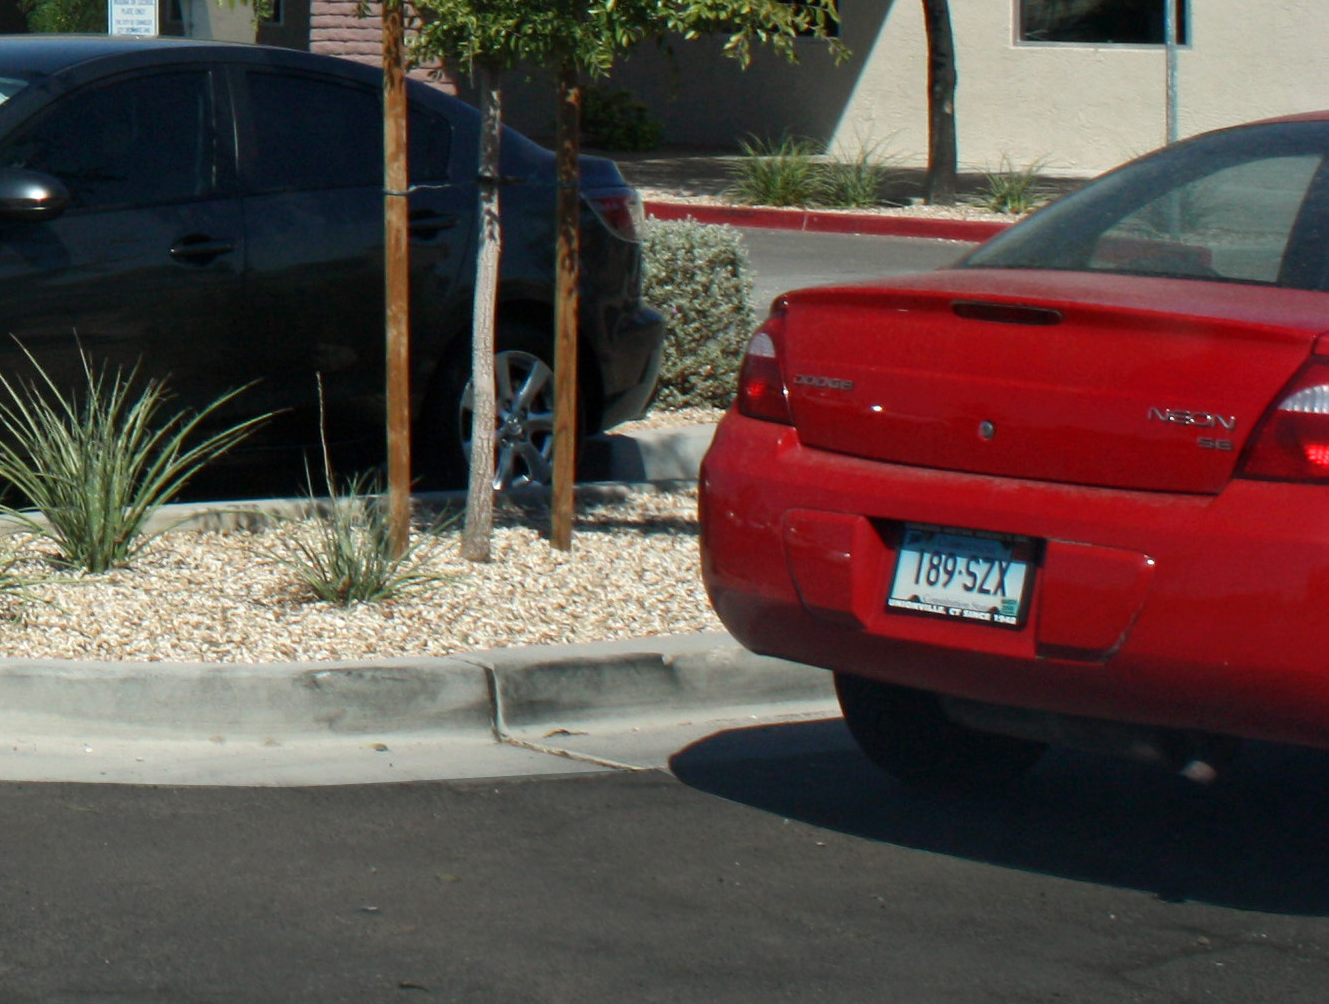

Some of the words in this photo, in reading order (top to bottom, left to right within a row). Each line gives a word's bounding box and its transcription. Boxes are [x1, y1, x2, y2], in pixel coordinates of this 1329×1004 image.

[793, 374, 854, 391] DODGE
[1147, 407, 1236, 431] NEON
[1197, 437, 1233, 451] SE
